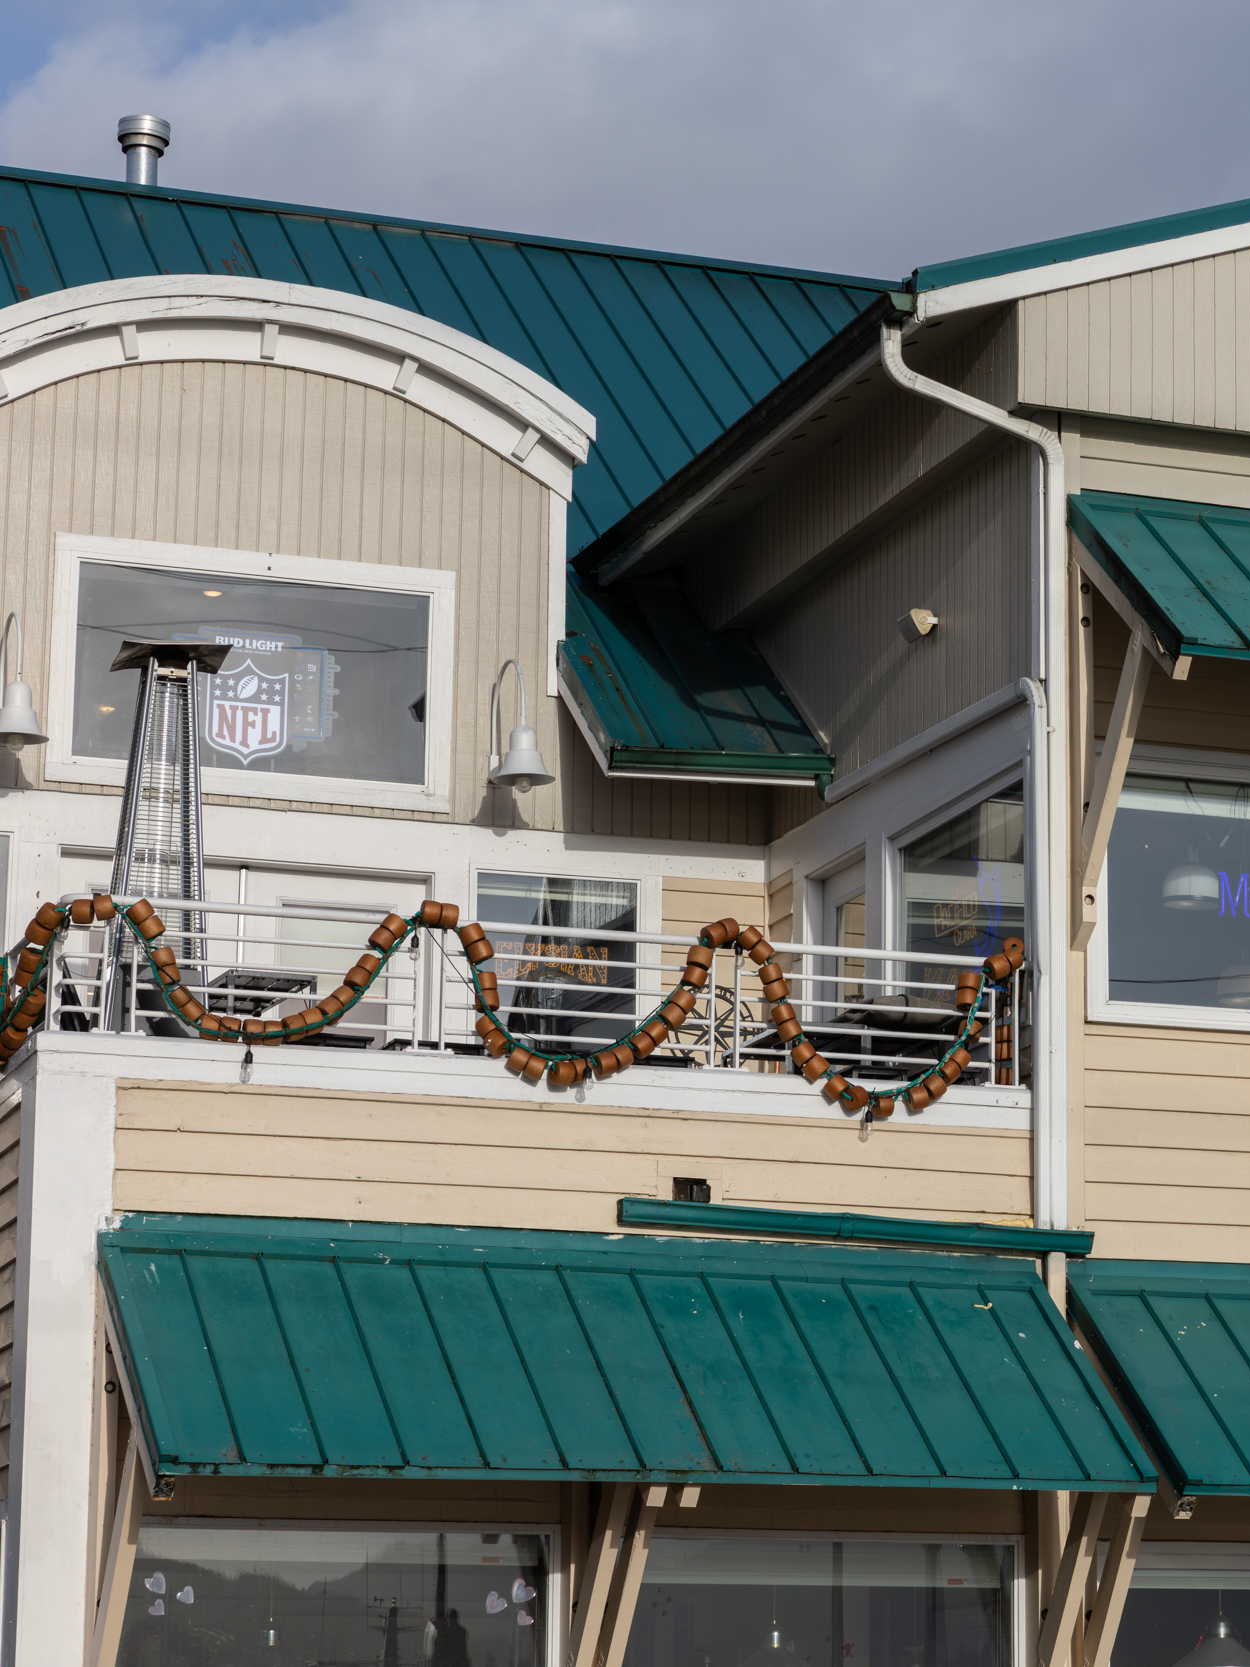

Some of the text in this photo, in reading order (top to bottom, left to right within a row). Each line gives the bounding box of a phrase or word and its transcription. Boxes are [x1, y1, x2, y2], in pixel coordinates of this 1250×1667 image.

[215, 636, 285, 652] BUD LIGHT
[215, 703, 277, 750] NFL
[933, 891, 978, 938] PACIFICO
[953, 924, 978, 946] CLARA
[495, 941, 608, 984] ELYSIAN
